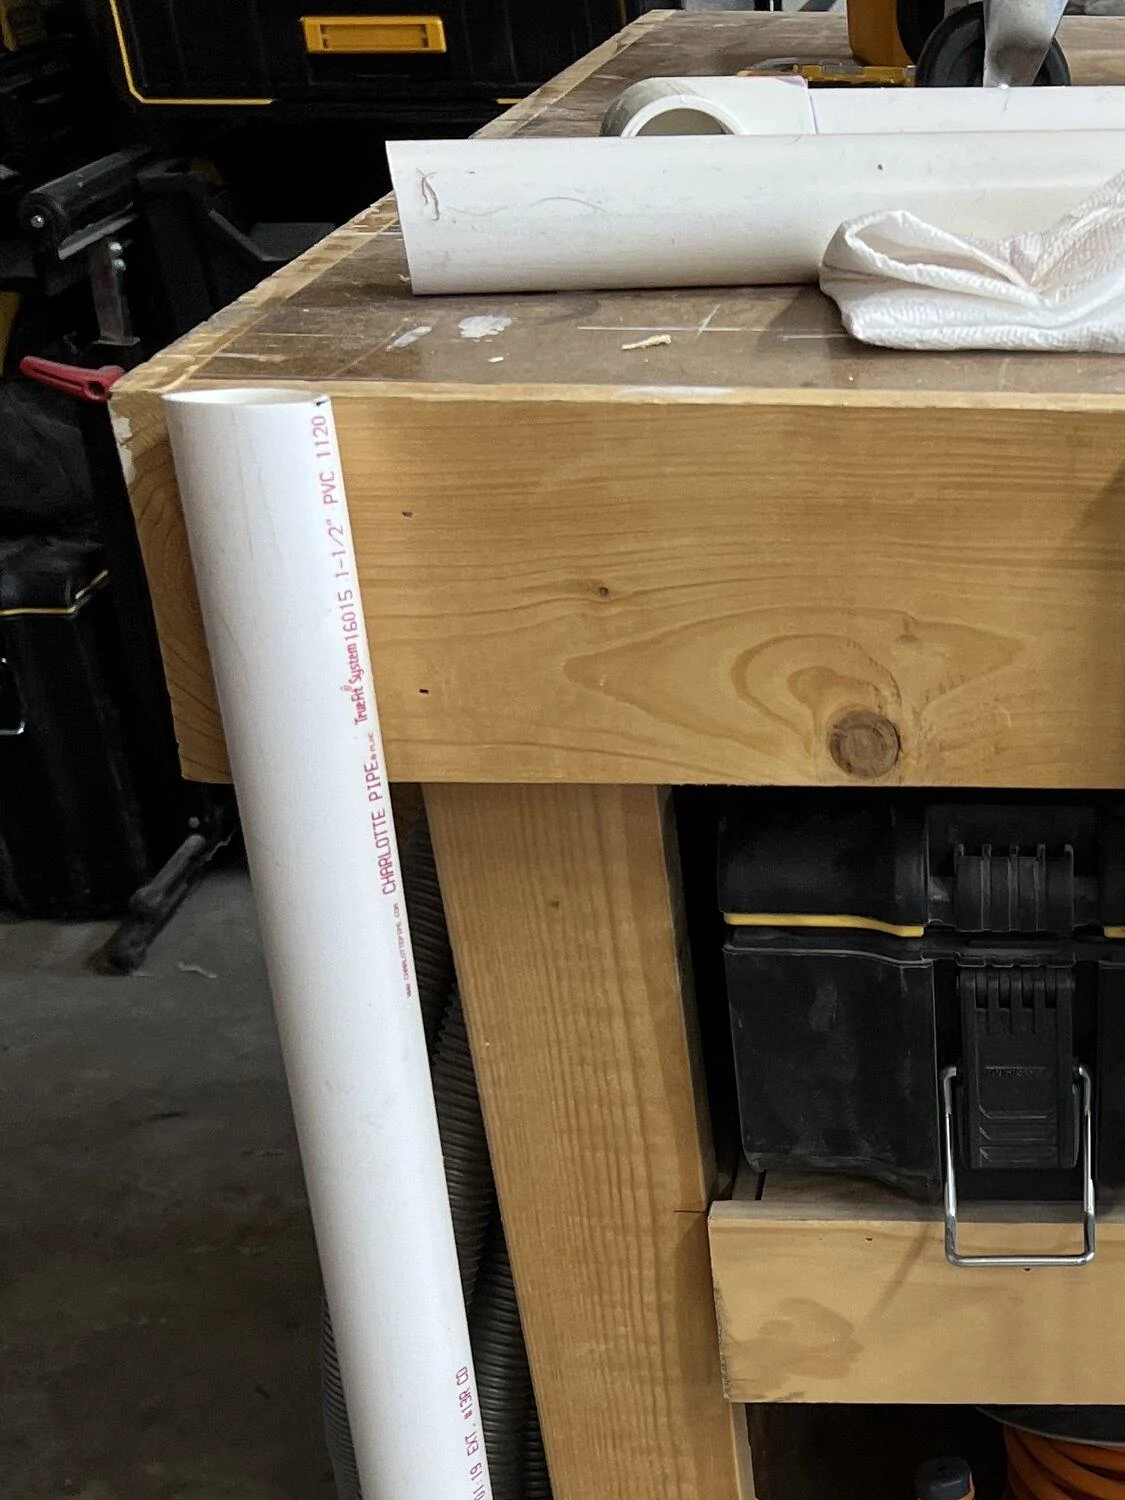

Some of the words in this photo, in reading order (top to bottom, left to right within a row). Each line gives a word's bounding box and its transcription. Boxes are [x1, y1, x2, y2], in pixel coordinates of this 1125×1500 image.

[311, 415, 331, 458] 1120
[320, 471, 339, 505] PVC
[338, 589, 359, 641] 16015
[347, 643, 365, 684] System
[363, 761, 383, 802] PIPE
[371, 808, 397, 895] CHARLOTTE
